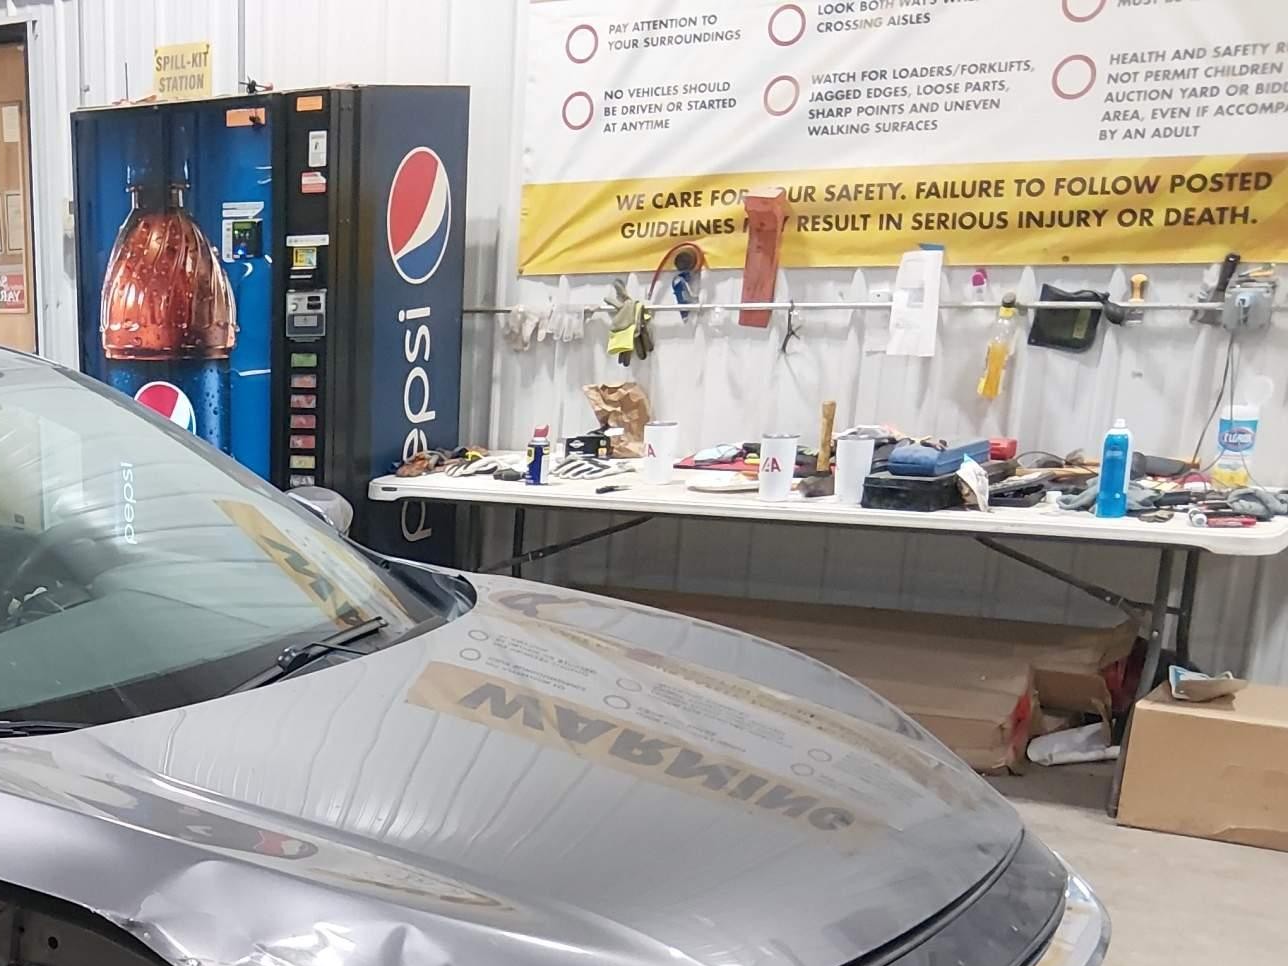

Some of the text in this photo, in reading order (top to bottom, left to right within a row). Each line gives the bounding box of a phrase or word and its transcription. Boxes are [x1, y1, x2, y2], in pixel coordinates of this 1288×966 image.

[818, 1, 855, 16] LOOK
[860, 0, 895, 12] BOTH
[609, 14, 718, 34] PAY ATTENTION TO
[817, 12, 931, 33] CROSSING AISLES
[608, 29, 741, 50] YOUR SURROUNDINGS
[156, 52, 208, 72] SPILL-KIT
[1110, 42, 1288, 65] HEALTH AND SAFETY R
[159, 73, 204, 92] STATION
[811, 60, 1035, 85] WATCH FOR LOADERS/FORKLIFTS,
[1107, 62, 1284, 85] NOT PERMIT CHILDREN
[604, 81, 731, 101] NO VEHICLES SHOULD
[809, 80, 1010, 103] JAGGED EDGES, LOOSE PARTS,
[1104, 88, 1173, 103] AUCTION
[1179, 85, 1220, 99] YARD
[1225, 83, 1250, 97] OR
[604, 98, 736, 117] BE DRIVEN OR STARTED
[808, 98, 1001, 120] SHARP POINTS AND UNEVEN
[1101, 109, 1144, 122] AREA,
[1151, 107, 1191, 120] EVEN
[1195, 105, 1209, 118] IF
[603, 118, 670, 133] AT ANYTIME
[808, 119, 938, 136] WALKING SURFACES
[1098, 125, 1200, 141] BY AN ADULT
[616, 193, 645, 211] WE
[651, 190, 702, 209] CARE
[824, 182, 906, 203] SAFETY.
[915, 179, 1005, 201] FAILURE
[1014, 177, 1045, 198] TO
[1053, 175, 1161, 197] FOLLOW
[1169, 171, 1273, 194] POSTED
[621, 217, 735, 240] GUIDELINES
[796, 213, 872, 233] RESULT
[878, 212, 903, 231] IN
[911, 210, 1009, 231] SERIOUS
[1017, 208, 1109, 229] INJURY
[1116, 207, 1155, 227] OR
[1163, 205, 1258, 227] DEATH.
